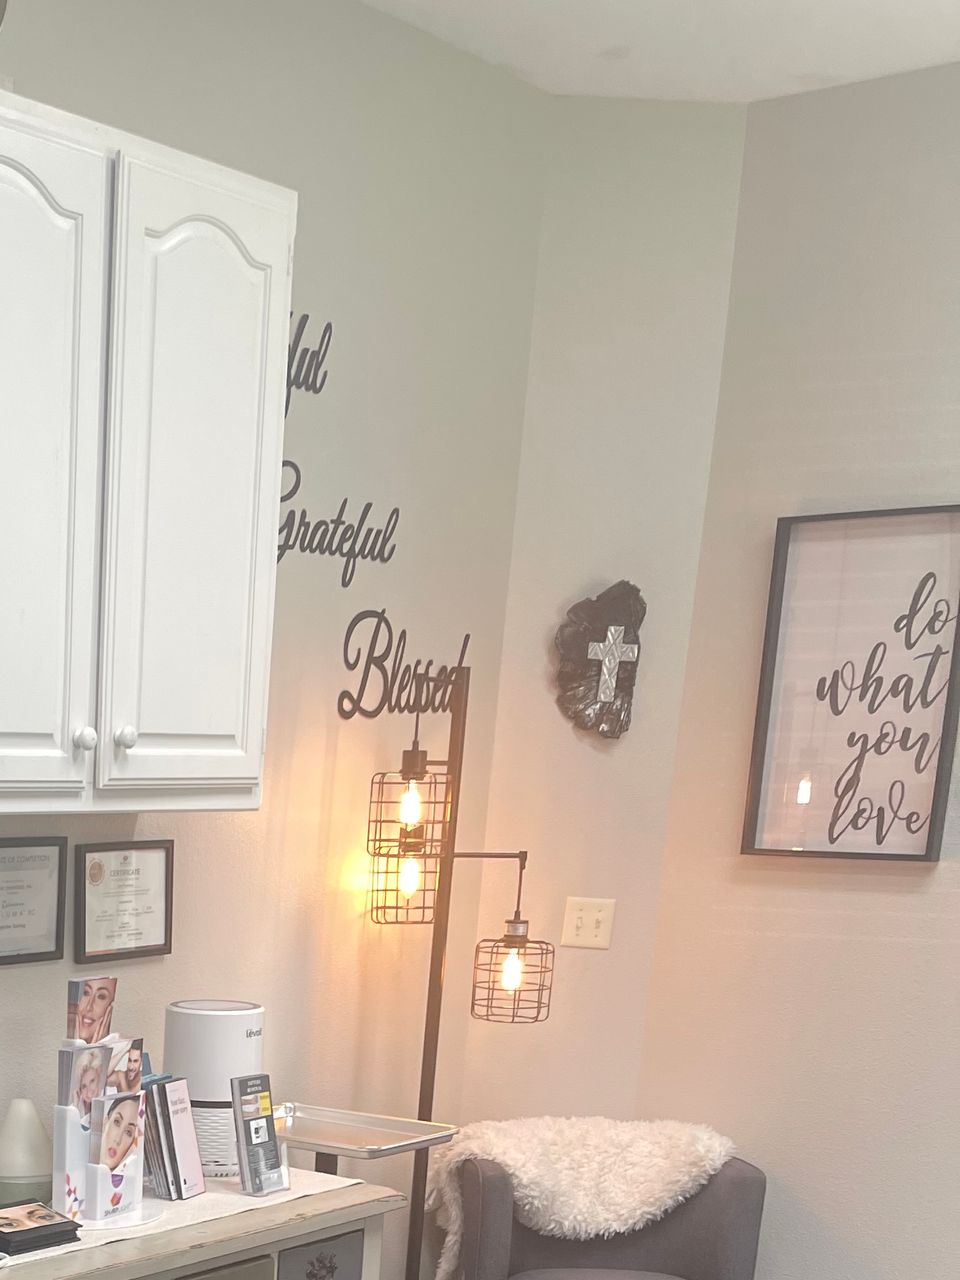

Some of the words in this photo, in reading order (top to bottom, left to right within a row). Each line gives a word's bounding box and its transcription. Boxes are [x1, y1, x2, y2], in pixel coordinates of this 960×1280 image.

[894, 571, 958, 651] do
[816, 641, 950, 717] what
[834, 720, 940, 800] you
[828, 772, 929, 846] love
